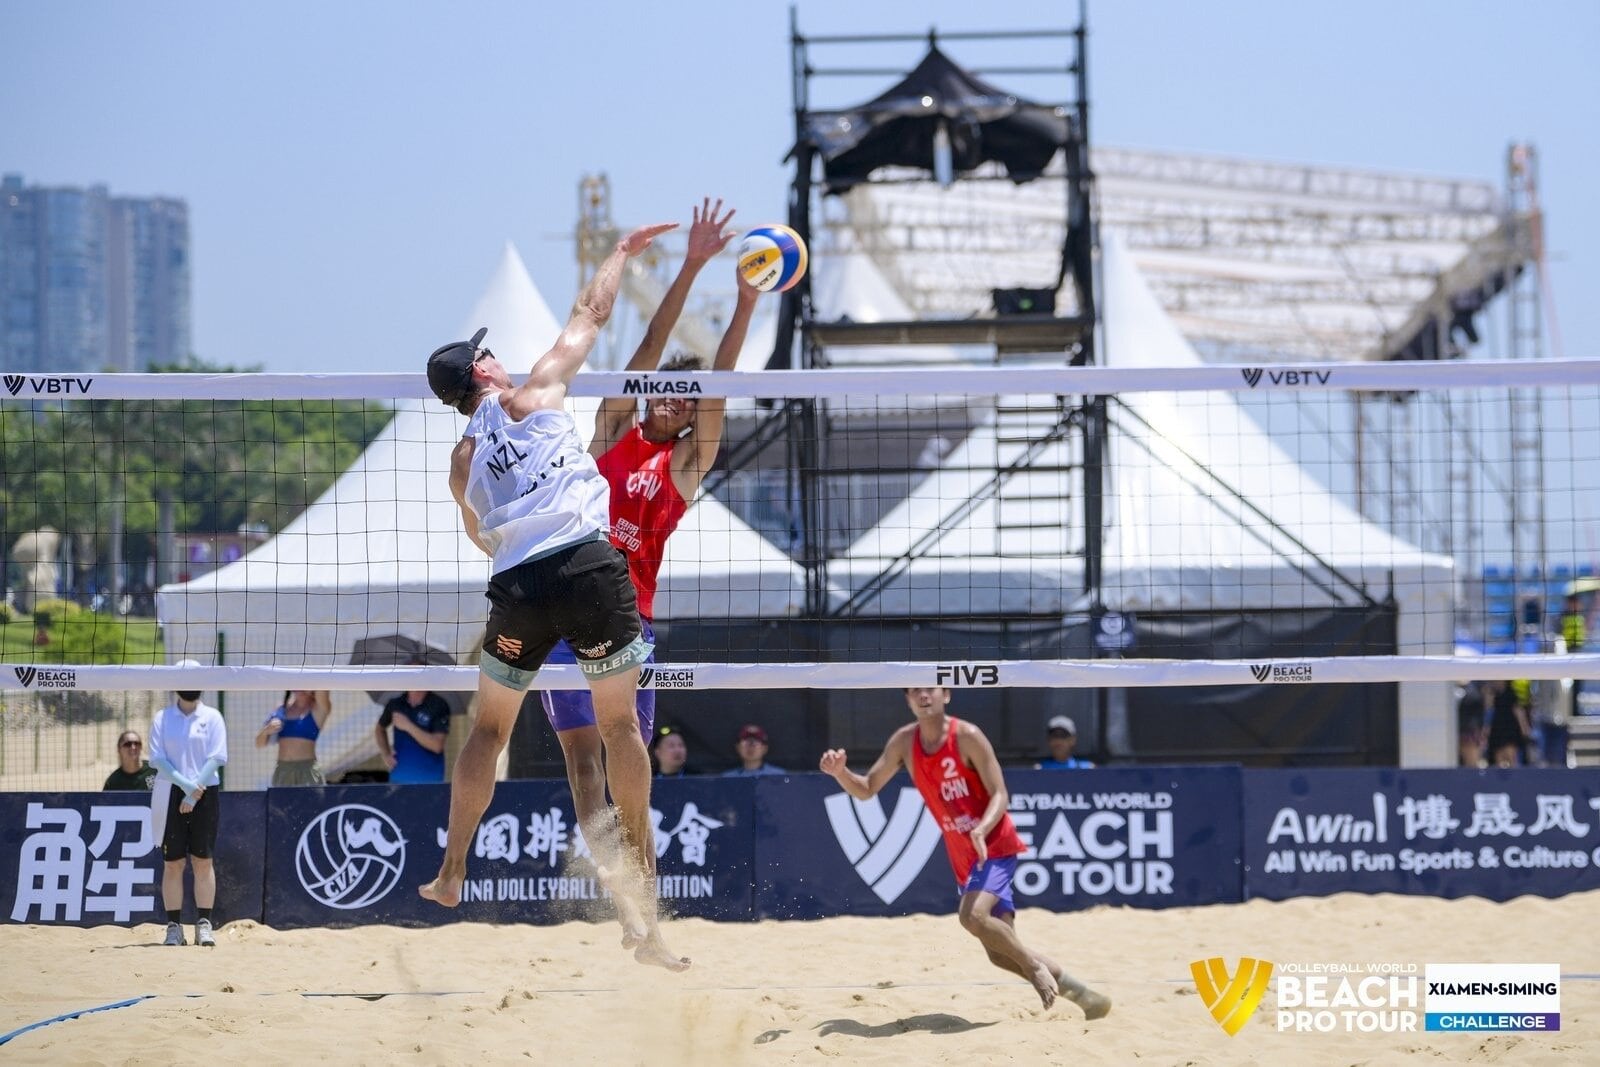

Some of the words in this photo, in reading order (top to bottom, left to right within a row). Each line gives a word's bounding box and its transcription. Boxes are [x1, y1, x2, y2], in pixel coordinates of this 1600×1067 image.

[30, 378, 92, 394] VBTV
[623, 374, 702, 394] MIKASA
[1268, 370, 1332, 386] VBTV
[487, 441, 528, 480] NZL
[626, 471, 662, 501] CHN
[38, 672, 76, 681] BEACH
[656, 672, 694, 681] BEACH
[1273, 667, 1312, 676] BEACH
[941, 757, 958, 779] 2
[940, 777, 969, 801] CHN
[1093, 792, 1173, 809] WORLD
[1396, 792, 1600, 838] 博晟风
[1010, 810, 1174, 860] EACH
[10, 802, 154, 922] 解
[1264, 850, 1296, 873] All
[1298, 850, 1348, 872] Win
[1350, 850, 1396, 872] Fun
[1398, 848, 1474, 875] Sports
[1478, 846, 1500, 868] &
[1502, 846, 1589, 868] Culture
[324, 862, 360, 898] CVA
[498, 876, 597, 901] VOLLEYBALL
[1054, 861, 1174, 896] TOUR
